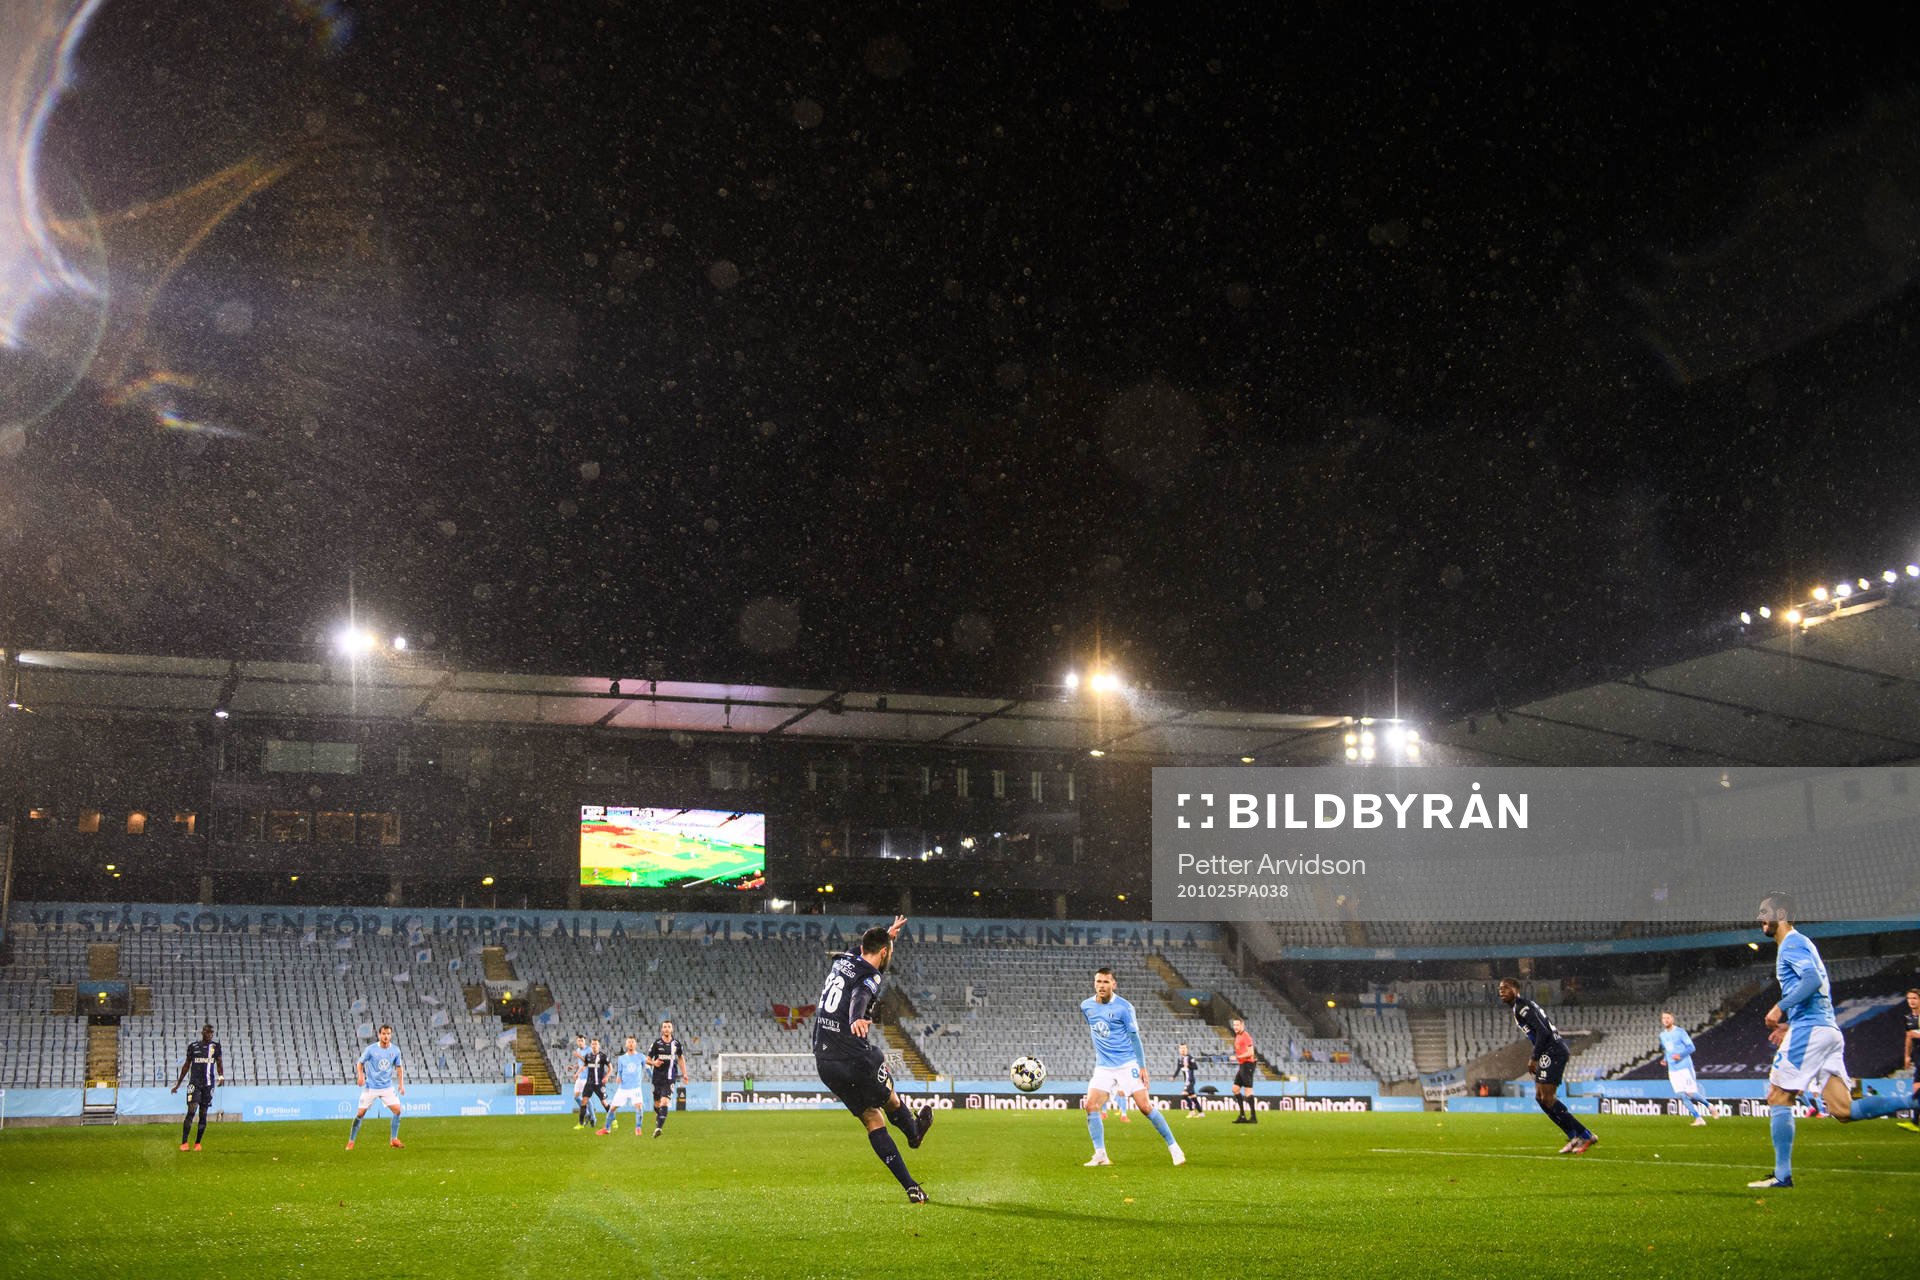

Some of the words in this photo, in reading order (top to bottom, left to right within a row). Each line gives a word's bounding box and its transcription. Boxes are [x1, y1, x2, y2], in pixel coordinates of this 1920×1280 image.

[174, 911, 249, 934] SOM
[392, 915, 540, 937] KUBBEN
[962, 925, 1026, 945] MEN
[1037, 926, 1100, 946] INTE
[1112, 927, 1197, 948] FALLA
[1131, 1068, 1140, 1079] 8
[984, 1094, 1067, 1110] limitado
[1295, 1097, 1366, 1112] limitado
[1611, 1099, 1661, 1116] limitado
